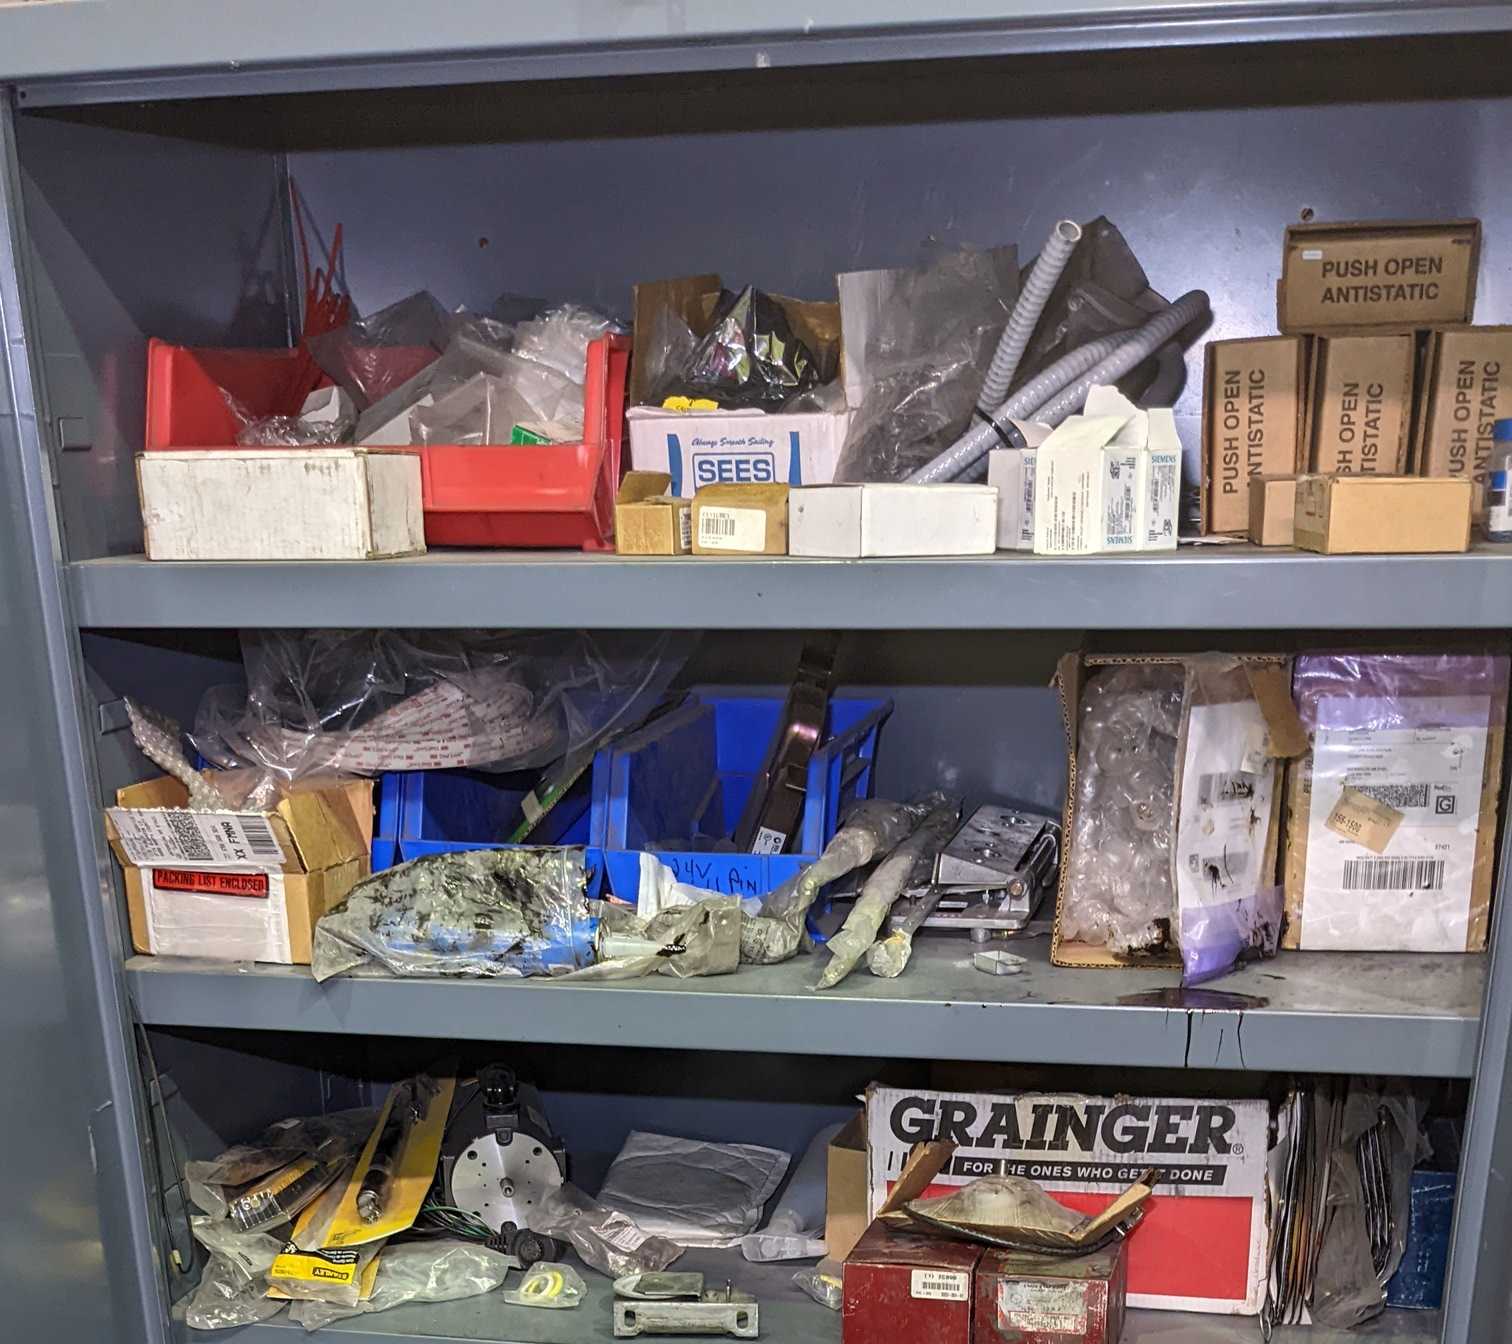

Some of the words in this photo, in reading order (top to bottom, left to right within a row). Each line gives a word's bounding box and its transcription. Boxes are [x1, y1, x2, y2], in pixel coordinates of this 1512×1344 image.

[1322, 259, 1378, 278] PUSH
[1384, 257, 1443, 276] OPEN
[1321, 282, 1439, 303] ANTISTATIC
[1224, 370, 1241, 430] OPEN
[1454, 360, 1476, 422] OPEN
[1340, 382, 1360, 447] OPEN
[1247, 368, 1266, 488] NTISTATIC
[1360, 382, 1384, 474] TISTATIC
[1151, 455, 1177, 464] SIEMENS
[1223, 436, 1240, 494] PUSH
[1448, 433, 1469, 477] USH
[698, 459, 772, 482] SEES
[1107, 536, 1133, 545] SIEMENS
[1438, 799, 1452, 811] G
[233, 848, 248, 860] XX
[157, 871, 195, 886] PACKING
[199, 875, 217, 888] LIST
[220, 876, 265, 892] ENCLOSED
[890, 1095, 1236, 1156] GRAINGER
[963, 1161, 994, 1175] FOR
[1007, 1163, 1026, 1176] HE
[1030, 1164, 1072, 1178] ONES
[1077, 1166, 1114, 1179] WHO
[1170, 1168, 1215, 1182] DONE
[314, 1267, 349, 1281] STANLEY
